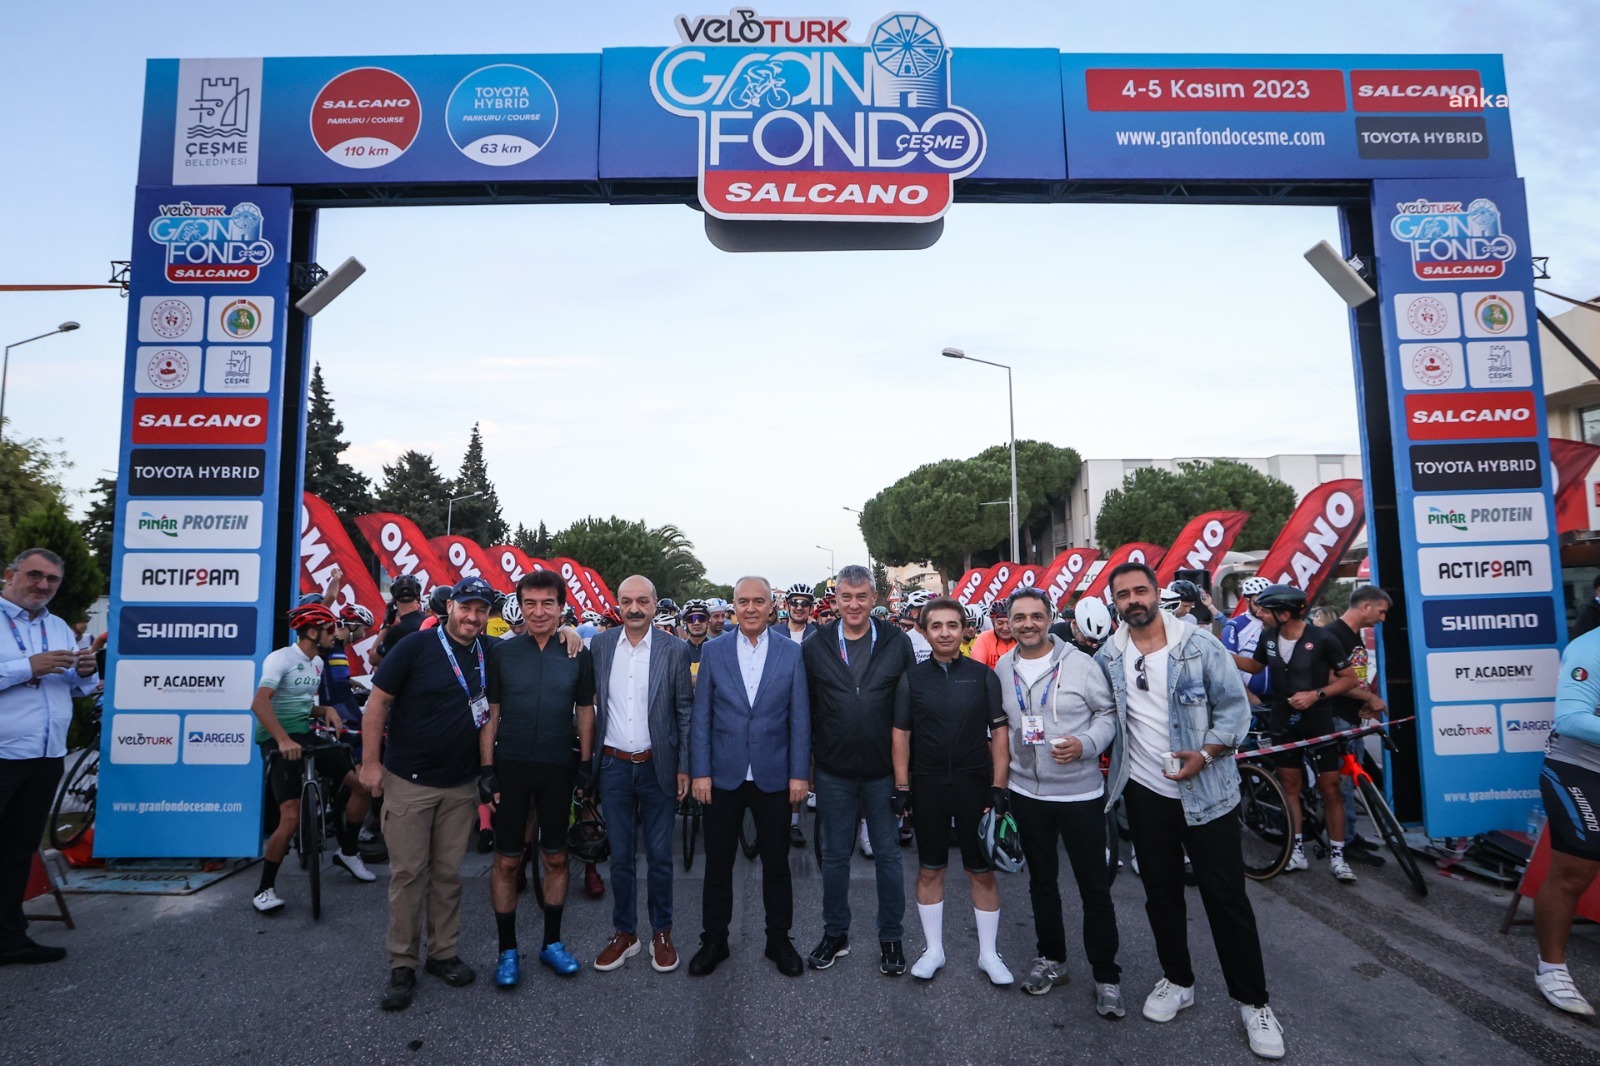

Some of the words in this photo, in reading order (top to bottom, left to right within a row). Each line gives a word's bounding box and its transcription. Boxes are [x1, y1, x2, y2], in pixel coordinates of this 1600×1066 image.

[475, 86, 530, 98] TOYOTA
[1121, 79, 1163, 98] 4-5
[1170, 79, 1245, 98] Kasım
[1252, 79, 1311, 99] 2023
[1358, 85, 1476, 97] SALCANO
[322, 98, 411, 109] SALCANO
[474, 98, 530, 109] HYBRID
[327, 117, 365, 125] PARKURU
[371, 116, 404, 124] COURSE
[462, 114, 501, 122] PARKURU
[507, 113, 541, 121] COURSE
[710, 111, 979, 168] FONDO
[896, 134, 965, 153] ÇEŞME
[1116, 127, 1326, 148] www.granfondocesme.com
[1361, 131, 1421, 144] TOYOTA
[1424, 131, 1484, 144] HYBRID
[185, 141, 248, 158] ÇEŞME
[344, 146, 365, 156] 110
[368, 145, 389, 156] km
[480, 143, 498, 154] 63
[501, 143, 522, 153] km
[725, 182, 929, 205] SALCANO
[169, 242, 271, 264] FONDO
[1414, 237, 1513, 261] FONDO
[174, 269, 250, 278] SALCANO
[1423, 265, 1496, 275] SALCANO
[138, 414, 262, 427] SALCANO
[1412, 408, 1530, 424] SALCANO
[134, 466, 194, 479] TOYOTA
[198, 466, 260, 479] HYBRID
[1415, 461, 1475, 475] TOYOTA
[1477, 459, 1537, 473] HYBRID
[1438, 560, 1533, 579] ACTIFOAM
[141, 568, 240, 586] ACTIFOAM
[1441, 613, 1539, 631] SHIMANO
[137, 623, 239, 639] SHIMANO
[1522, 720, 1554, 730] ARGEU
[204, 733, 245, 743] ARGEUS
[1443, 788, 1542, 803] www.granfondocesm
[112, 800, 242, 814] www.granfondocesme.com
[1567, 786, 1600, 832] SHIMANO
